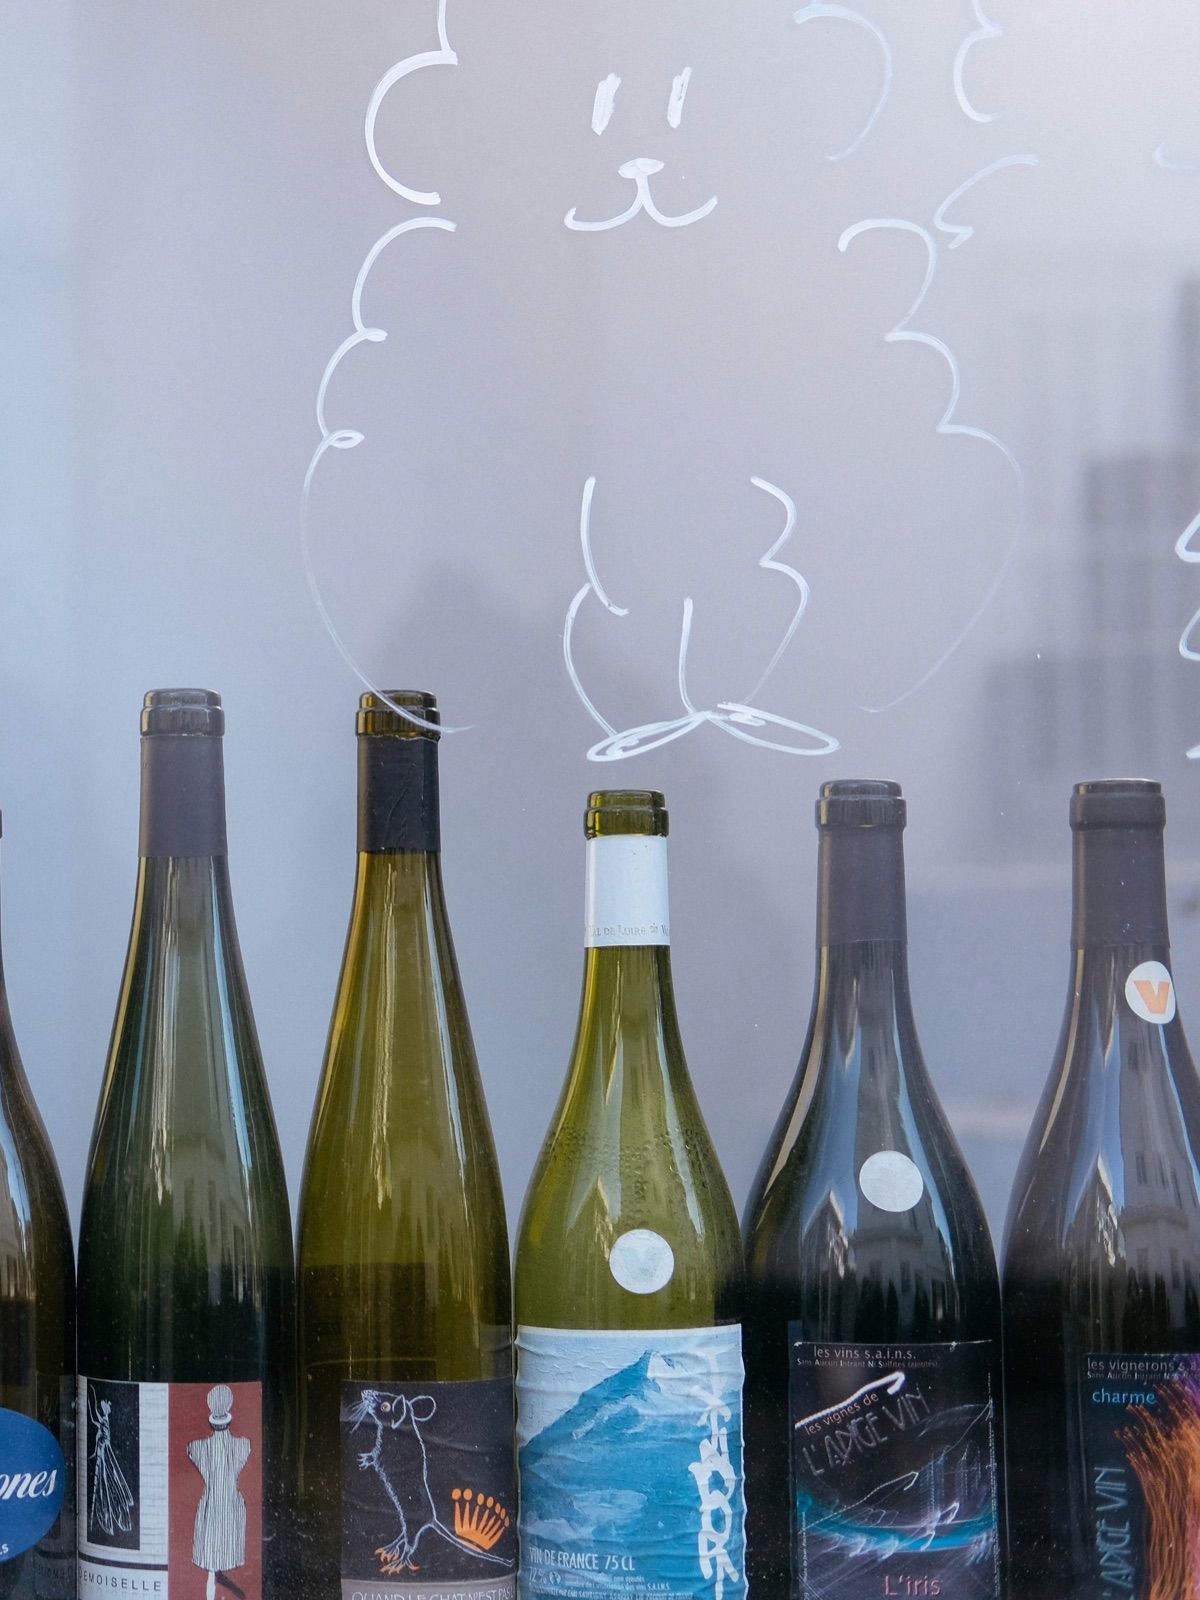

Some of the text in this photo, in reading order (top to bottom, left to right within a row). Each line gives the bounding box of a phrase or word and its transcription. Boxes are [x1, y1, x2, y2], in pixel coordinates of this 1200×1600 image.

[1133, 979, 1171, 1015] V
[813, 1345, 917, 1360] les vins s.a.i.n.s.
[1087, 1357, 1105, 1371] les
[1109, 1358, 1175, 1374] vignerons
[1092, 1387, 1157, 1405] charme
[804, 1392, 880, 1436] les vignes de
[528, 1547, 636, 1571] VIN DE FRANCE 75 CL
[885, 1575, 941, 1596] L'iris
